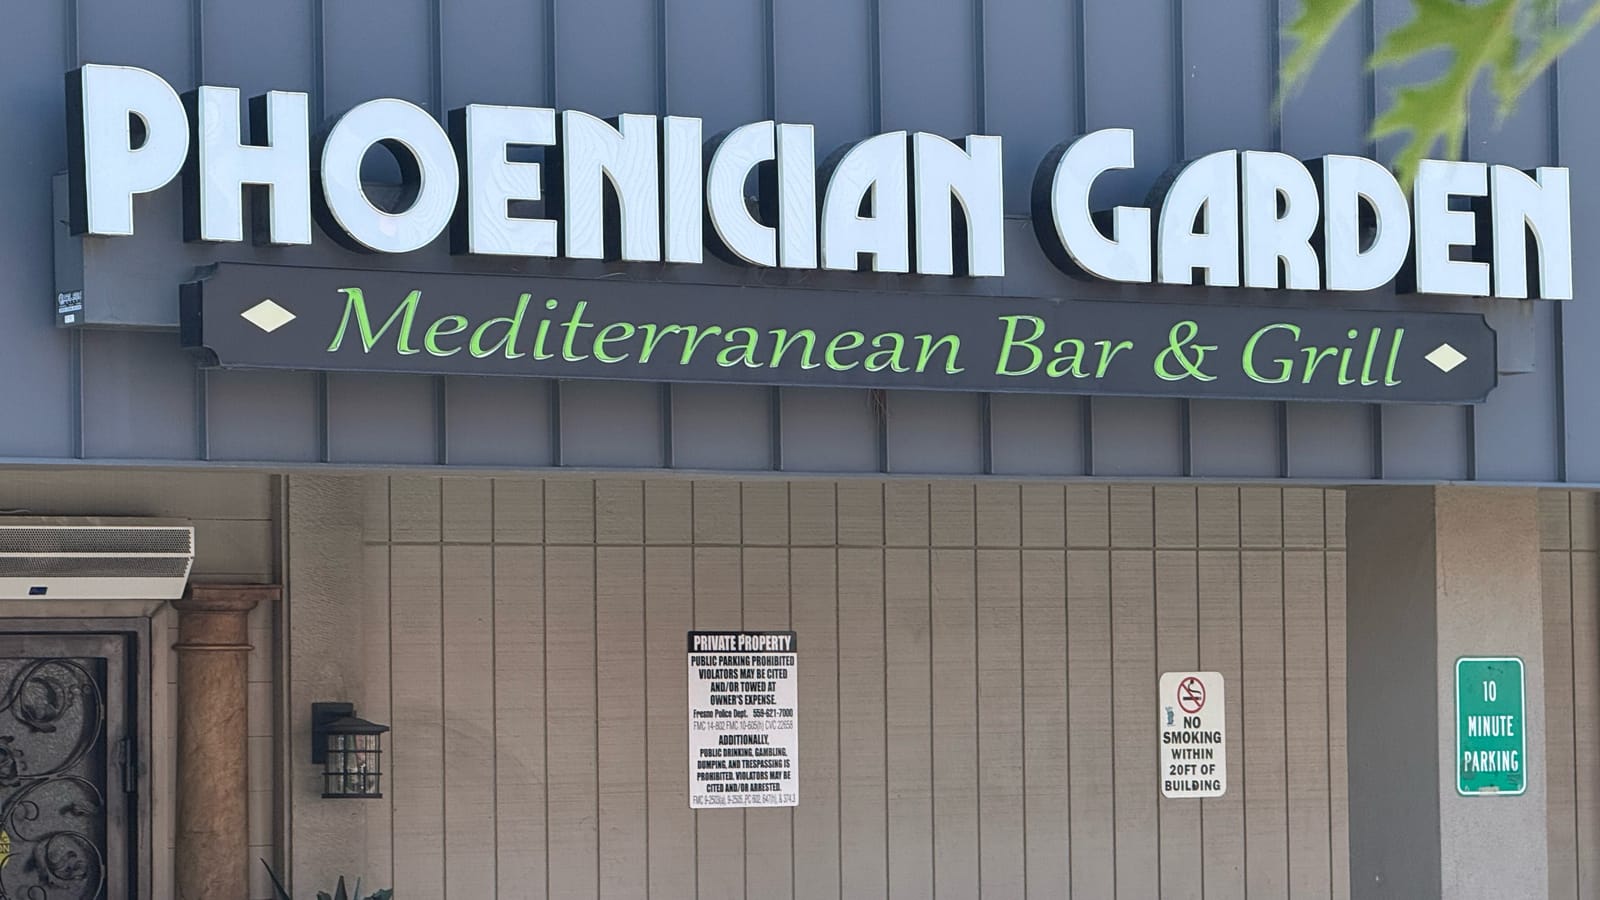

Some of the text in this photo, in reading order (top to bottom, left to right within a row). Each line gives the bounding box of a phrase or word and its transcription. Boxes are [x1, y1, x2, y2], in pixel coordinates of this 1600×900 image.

[80, 63, 1574, 301] PHOENICIAN GARDEN
[327, 286, 1406, 387] Mediterranean Bar & Grill
[693, 634, 791, 652] PRIVATE PROPERTY
[691, 655, 795, 667] PUBLIC PARKING PROHIBITED
[699, 668, 788, 680] VIOLATORS MAY BE CITED
[710, 681, 776, 693] AND/OR TOWED AT
[1483, 680, 1497, 702] 10
[710, 694, 777, 706] OWNER'S EXPENSE.
[693, 708, 714, 719] Fresno
[715, 708, 732, 719] Police
[733, 708, 748, 720] Dept.
[1183, 716, 1201, 729] NO
[1468, 715, 1514, 737] MINUTE
[719, 734, 770, 746] ADDITIONALLY,
[1163, 731, 1222, 744] SMOKING
[700, 748, 722, 758] PUBLIC
[723, 748, 754, 758] DRINKING,
[1171, 748, 1213, 760] WITHIN
[729, 760, 741, 769] AND
[742, 759, 783, 769] TRESPASSING
[784, 759, 791, 768] IS
[1464, 750, 1519, 773] PARKING
[736, 771, 768, 781] VIOLATORS
[770, 771, 782, 780] MAY
[783, 771, 791, 780] BE
[1169, 764, 1216, 776] 20FT OF
[706, 782, 782, 793] CITED AND/OR ARRESTED.
[1165, 780, 1221, 792] BUILDING
